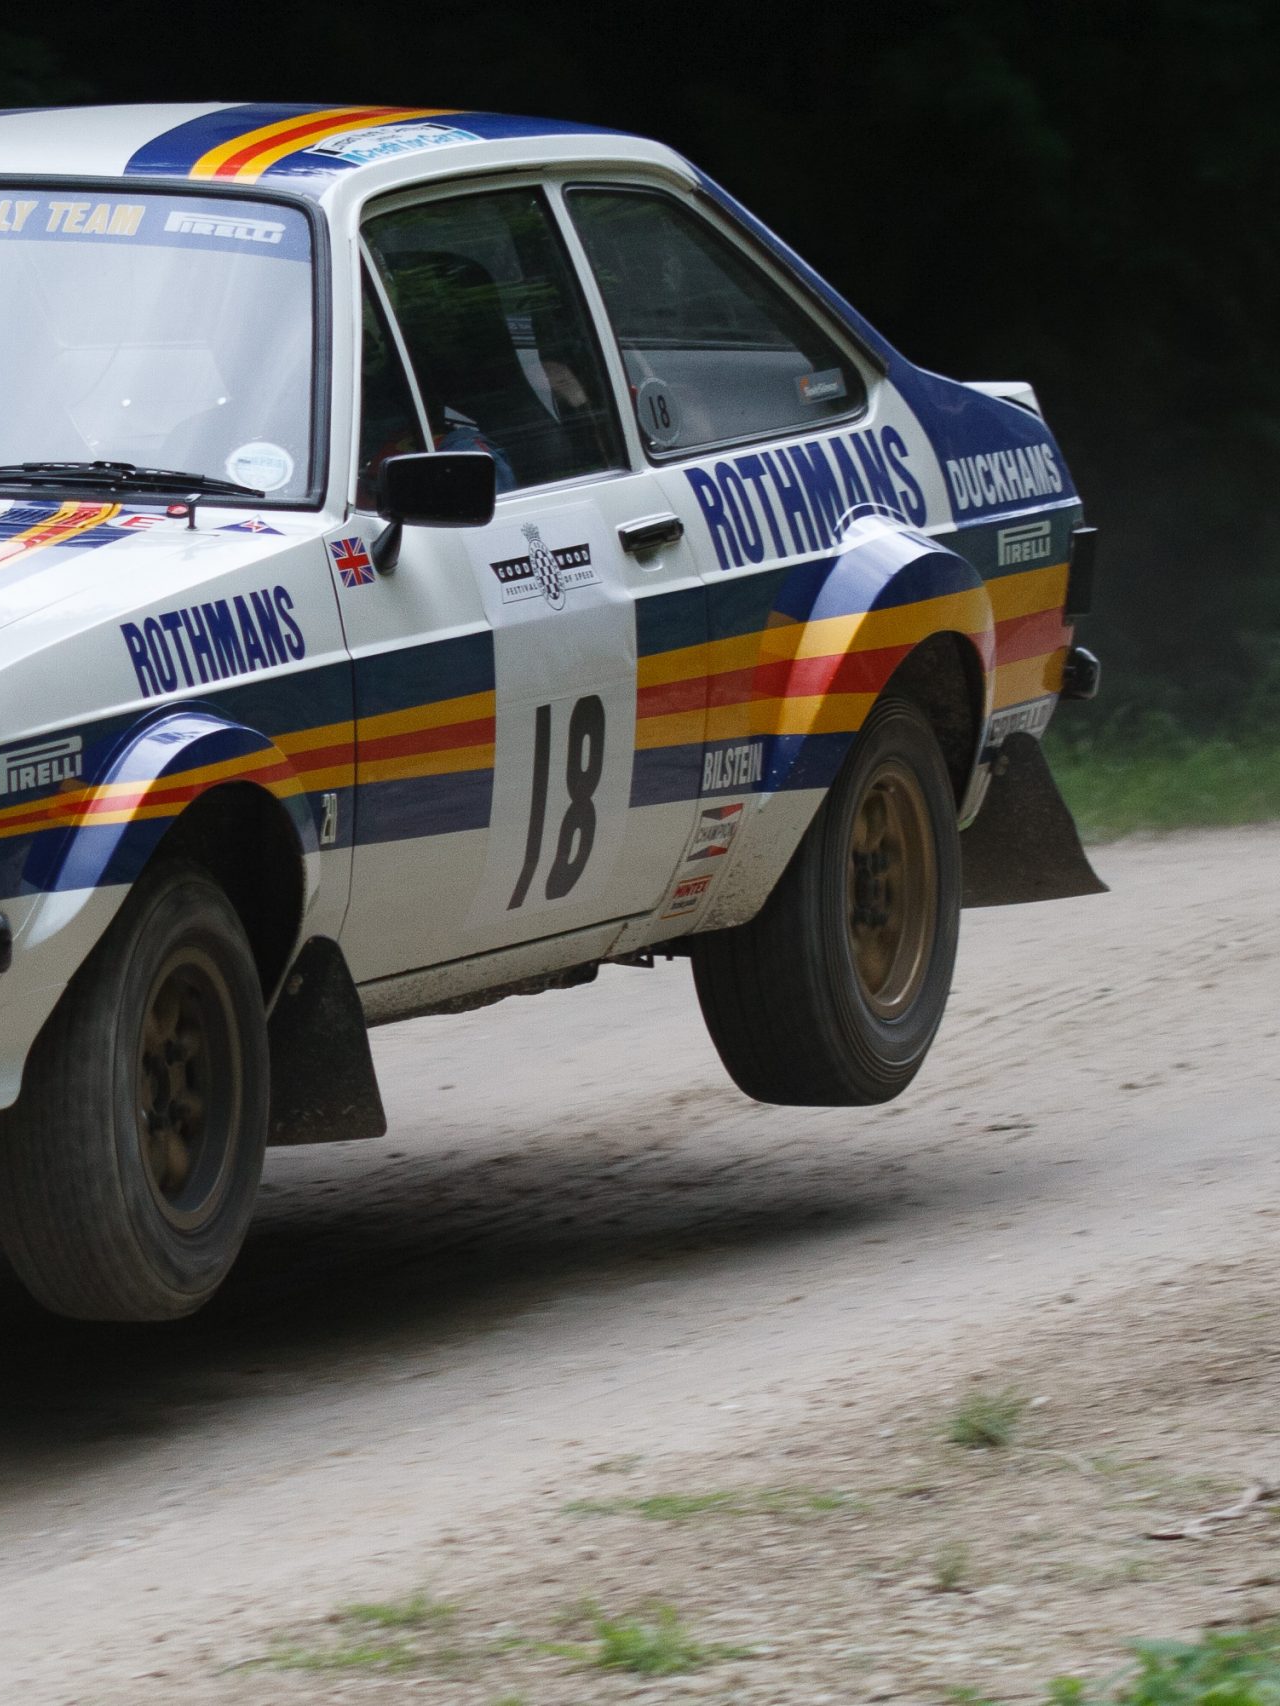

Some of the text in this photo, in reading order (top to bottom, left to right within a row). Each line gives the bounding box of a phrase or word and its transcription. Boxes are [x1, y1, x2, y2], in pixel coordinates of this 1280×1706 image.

[46, 202, 146, 236] TEAM
[164, 211, 287, 244] PIRELLI
[646, 392, 671, 430] 18
[684, 425, 928, 571] ROTHMANS
[946, 442, 1062, 511] DUCKHAMS
[498, 561, 531, 579] GOOD
[556, 549, 589, 566] WOOD
[998, 519, 1051, 566] PIRELLI
[506, 582, 538, 596] FESTIVAL
[574, 570, 595, 582] SPEED
[120, 585, 306, 699] ROTHMANS
[702, 742, 763, 792] BILSTEIN
[505, 694, 606, 911] 18
